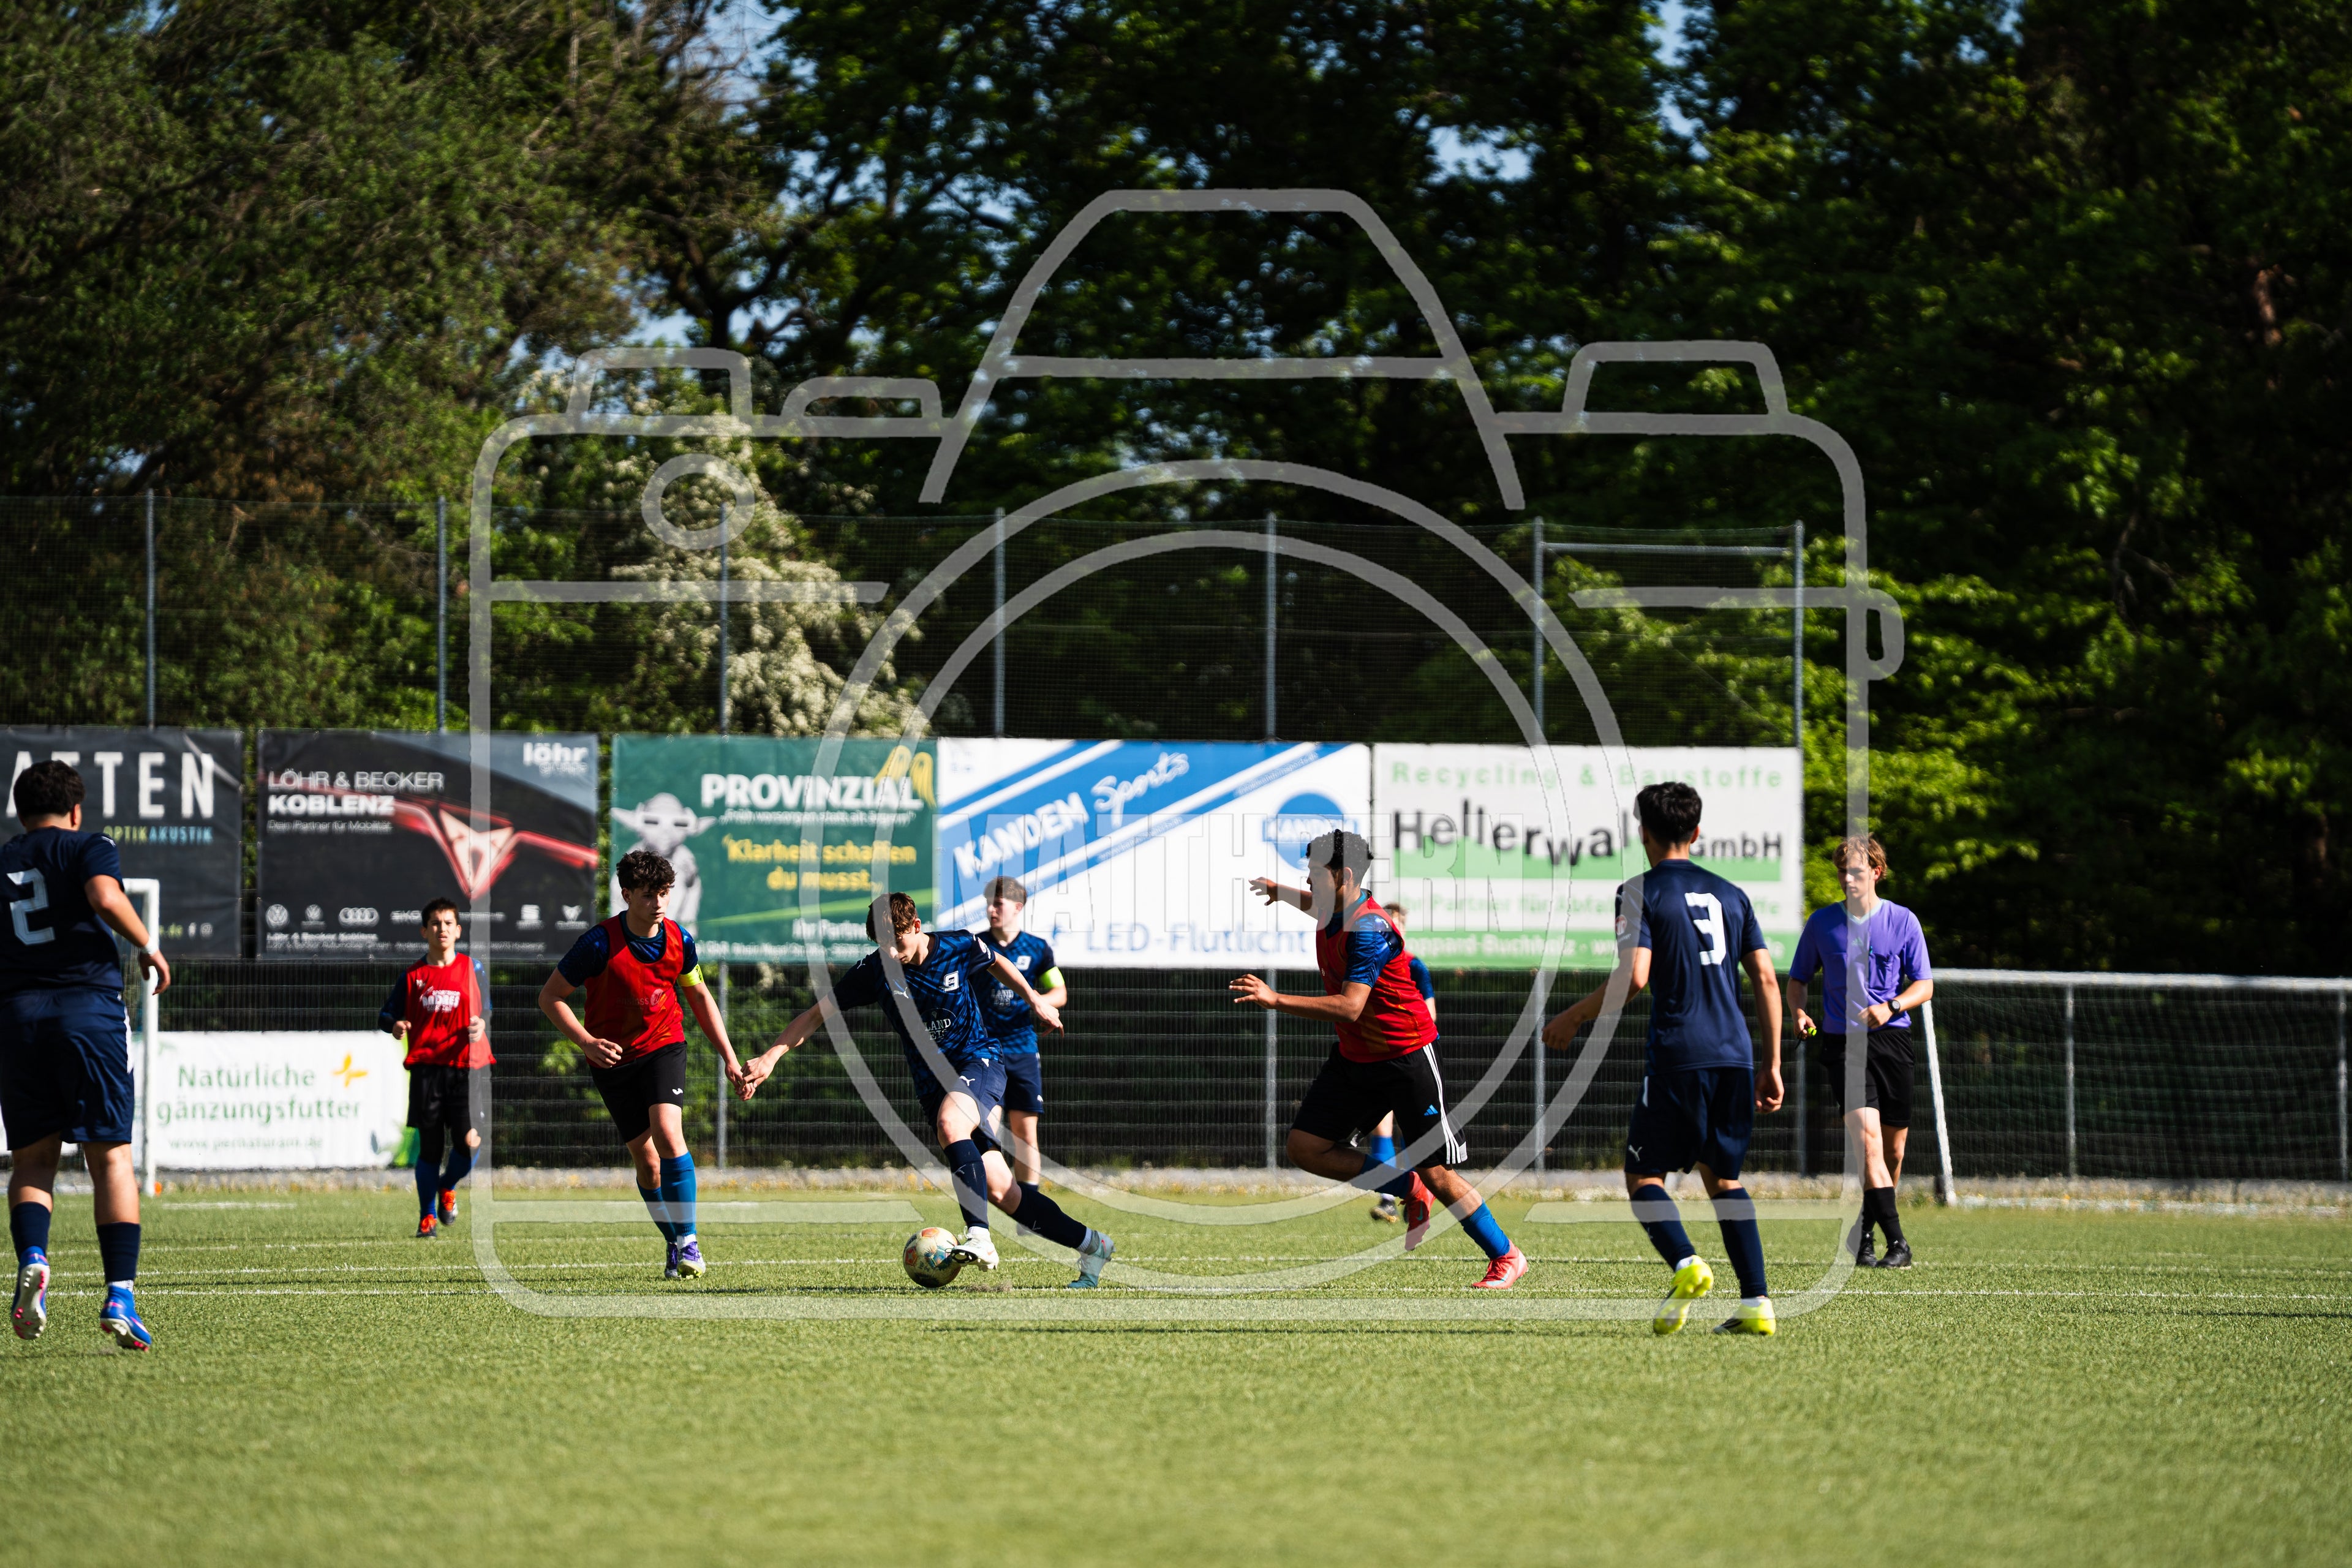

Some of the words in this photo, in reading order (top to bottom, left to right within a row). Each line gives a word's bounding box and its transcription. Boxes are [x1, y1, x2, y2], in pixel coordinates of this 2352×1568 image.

[523, 742, 588, 765] löhr
[268, 769, 330, 792] LÖHR
[335, 771, 350, 788] &
[355, 771, 445, 792] BECKER
[1392, 762, 1557, 788] Recycling
[1580, 764, 1595, 786] &
[1619, 764, 1782, 786] Baustoffe
[701, 774, 924, 810] PROVINZIAL
[268, 795, 395, 816] KOBLENZ
[953, 791, 1090, 878] KANDEN
[1091, 752, 1190, 828] Sports
[1393, 799, 1629, 866] Hellerwal
[1689, 834, 1782, 859] GmbH
[767, 865, 797, 890] du
[6, 868, 55, 946] 2
[1684, 892, 1727, 965] 3
[924, 1017, 951, 1031] LAND
[178, 1063, 316, 1089] Natürliche
